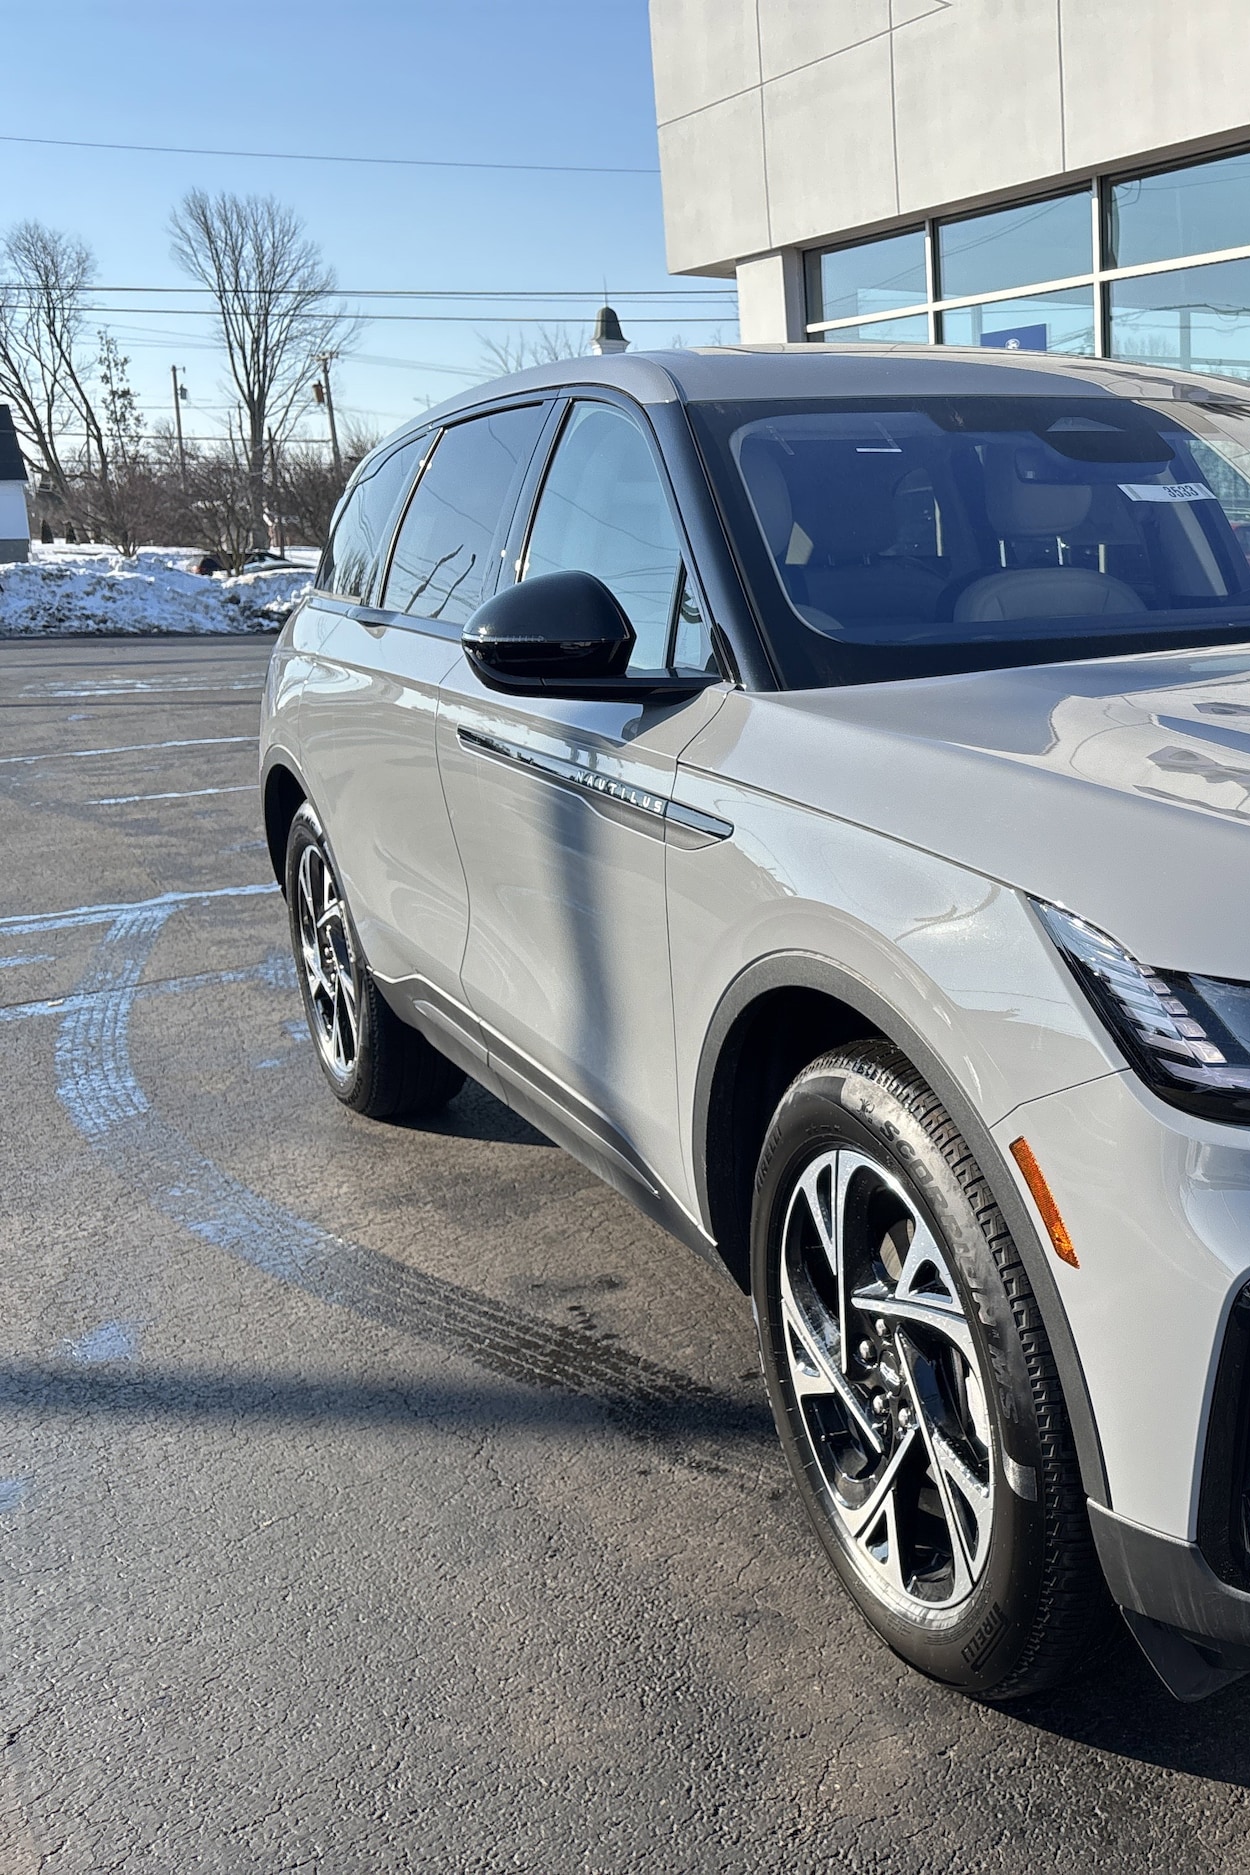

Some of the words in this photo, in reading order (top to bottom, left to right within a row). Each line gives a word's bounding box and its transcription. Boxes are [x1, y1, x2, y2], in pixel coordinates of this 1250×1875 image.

[1162, 485, 1199, 498] 3533
[575, 769, 663, 813] NAUTILUS
[879, 1119, 997, 1328] SCORPION
